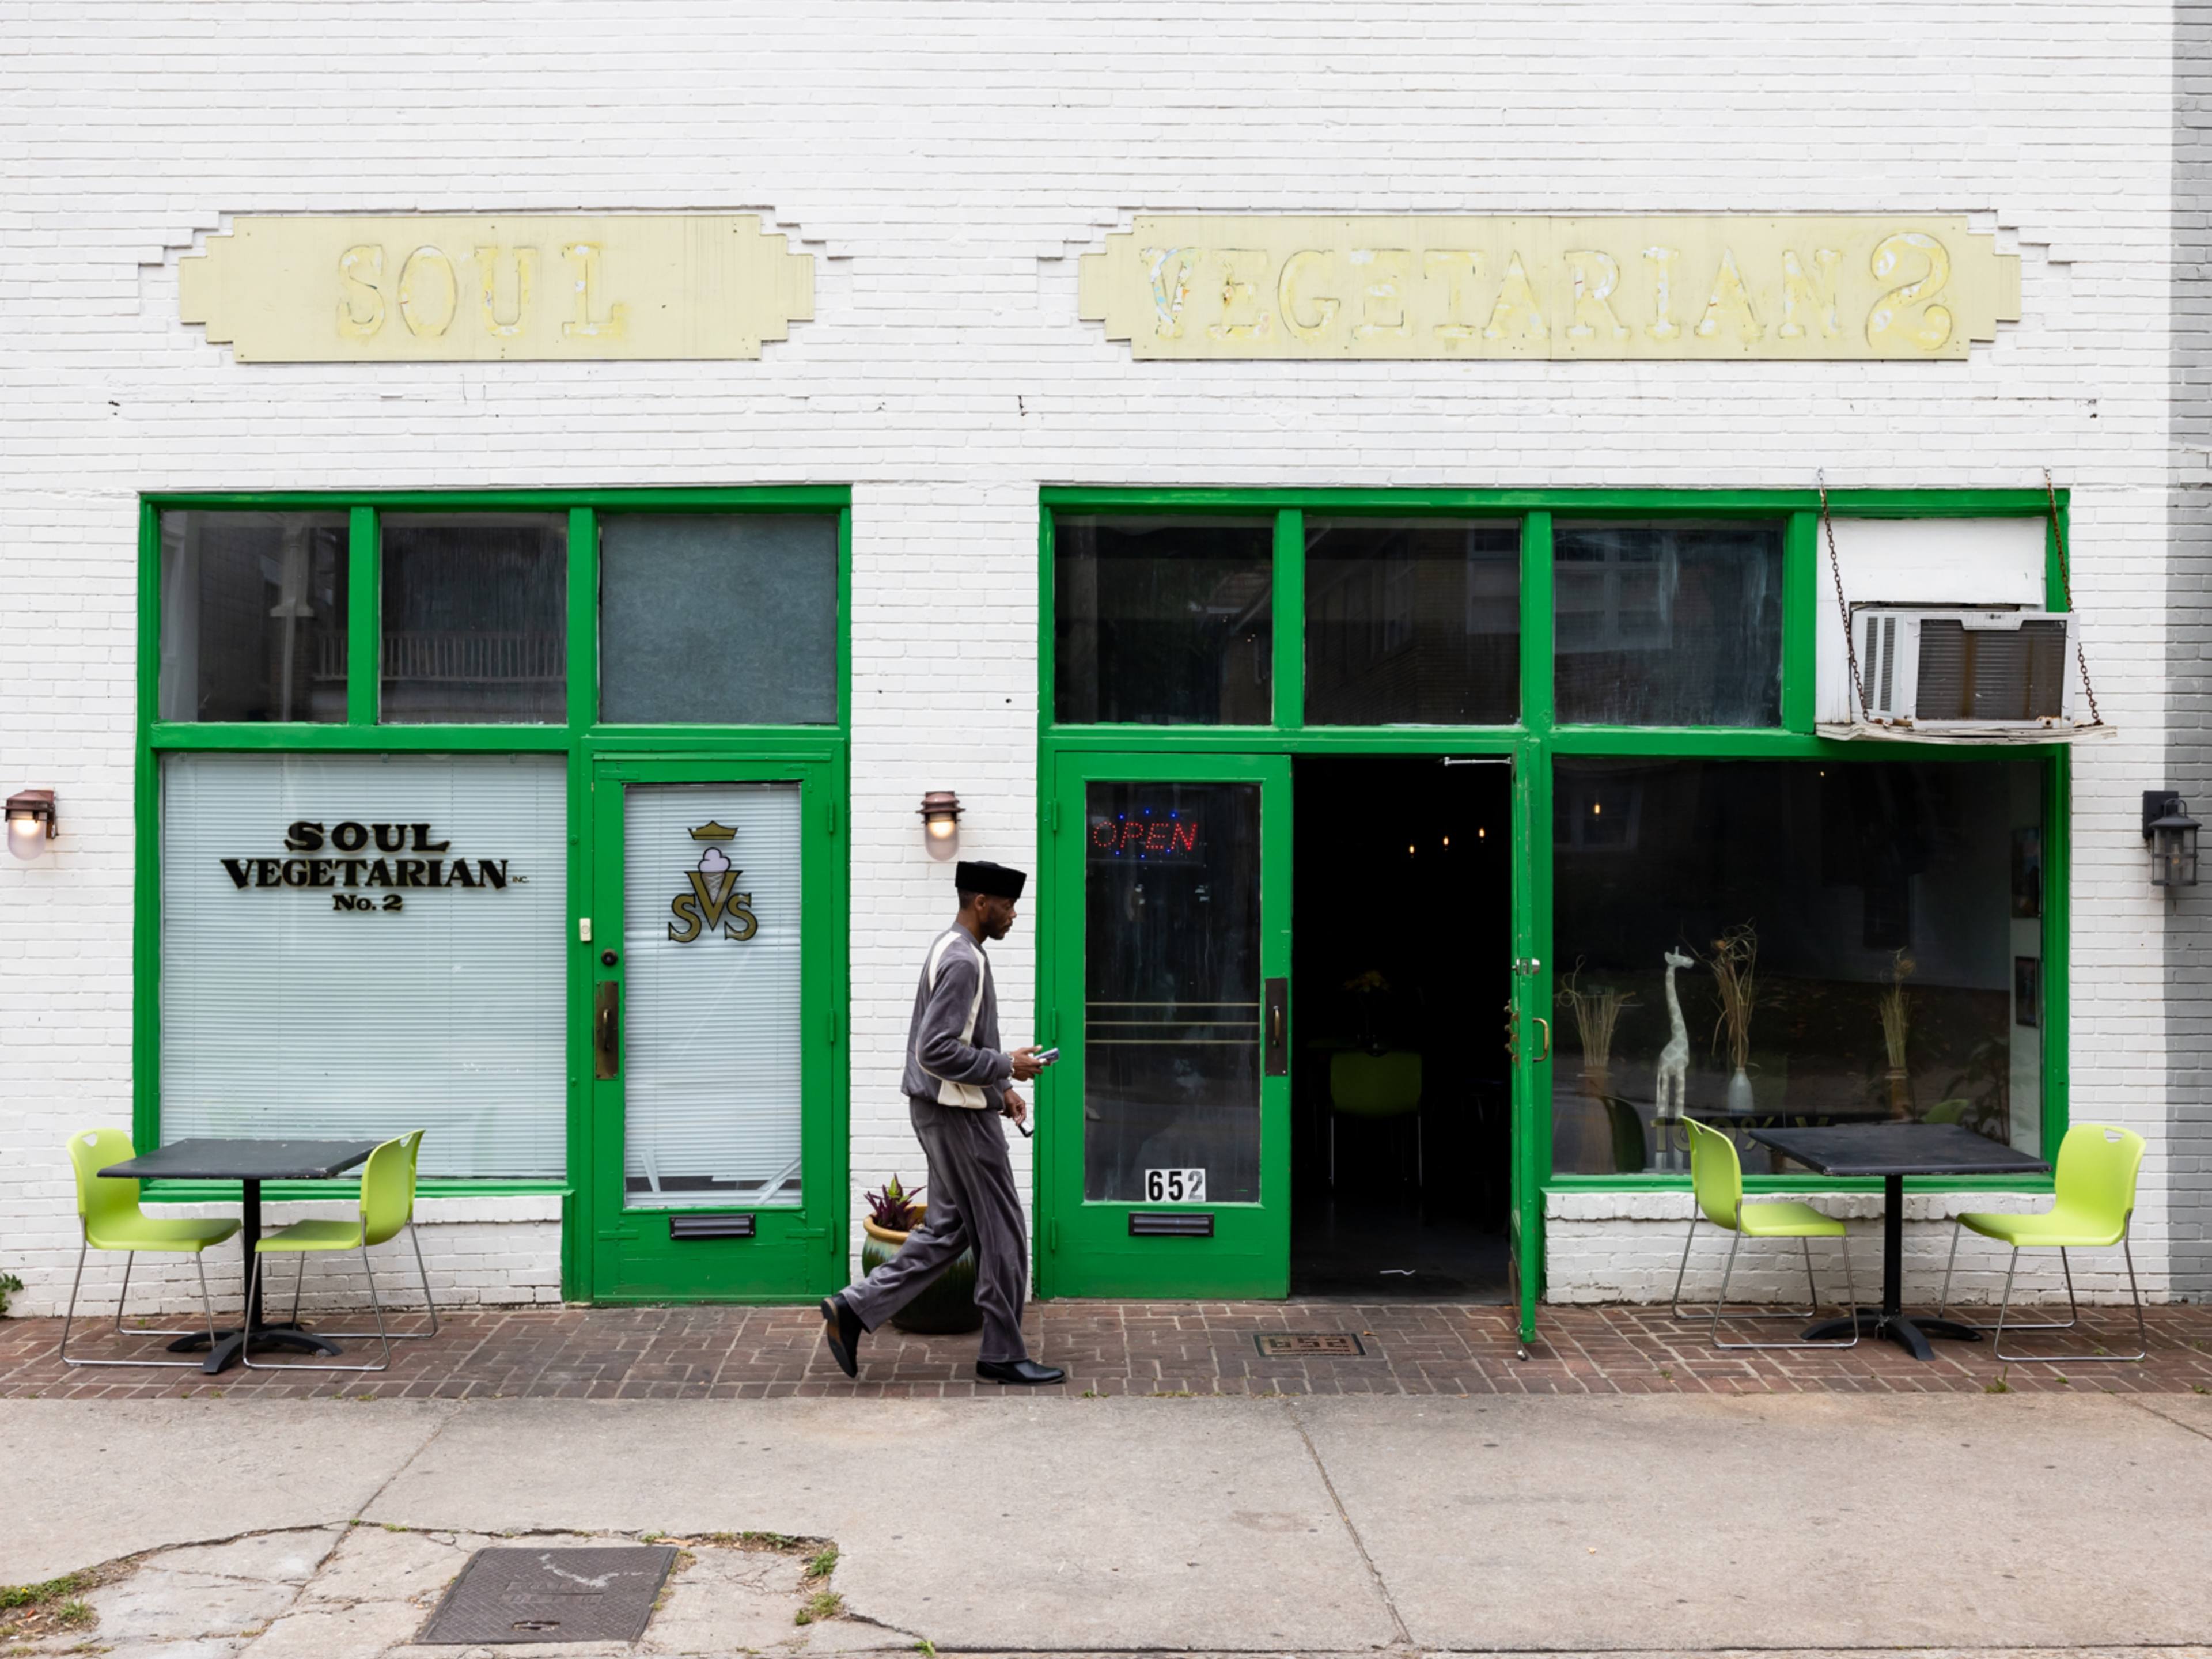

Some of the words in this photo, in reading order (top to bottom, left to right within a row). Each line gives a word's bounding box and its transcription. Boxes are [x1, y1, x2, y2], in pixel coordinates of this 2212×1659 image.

[338, 243, 624, 338] SOUL
[1139, 247, 1841, 340] VEGETARIAN
[1865, 231, 1953, 350] 2
[283, 821, 451, 852] SOUL
[1093, 821, 1198, 851] OPEN
[220, 857, 509, 890] VEGETARIAN
[332, 894, 377, 911] No.
[382, 894, 403, 911] 2
[1148, 1170, 1203, 1202] 652
